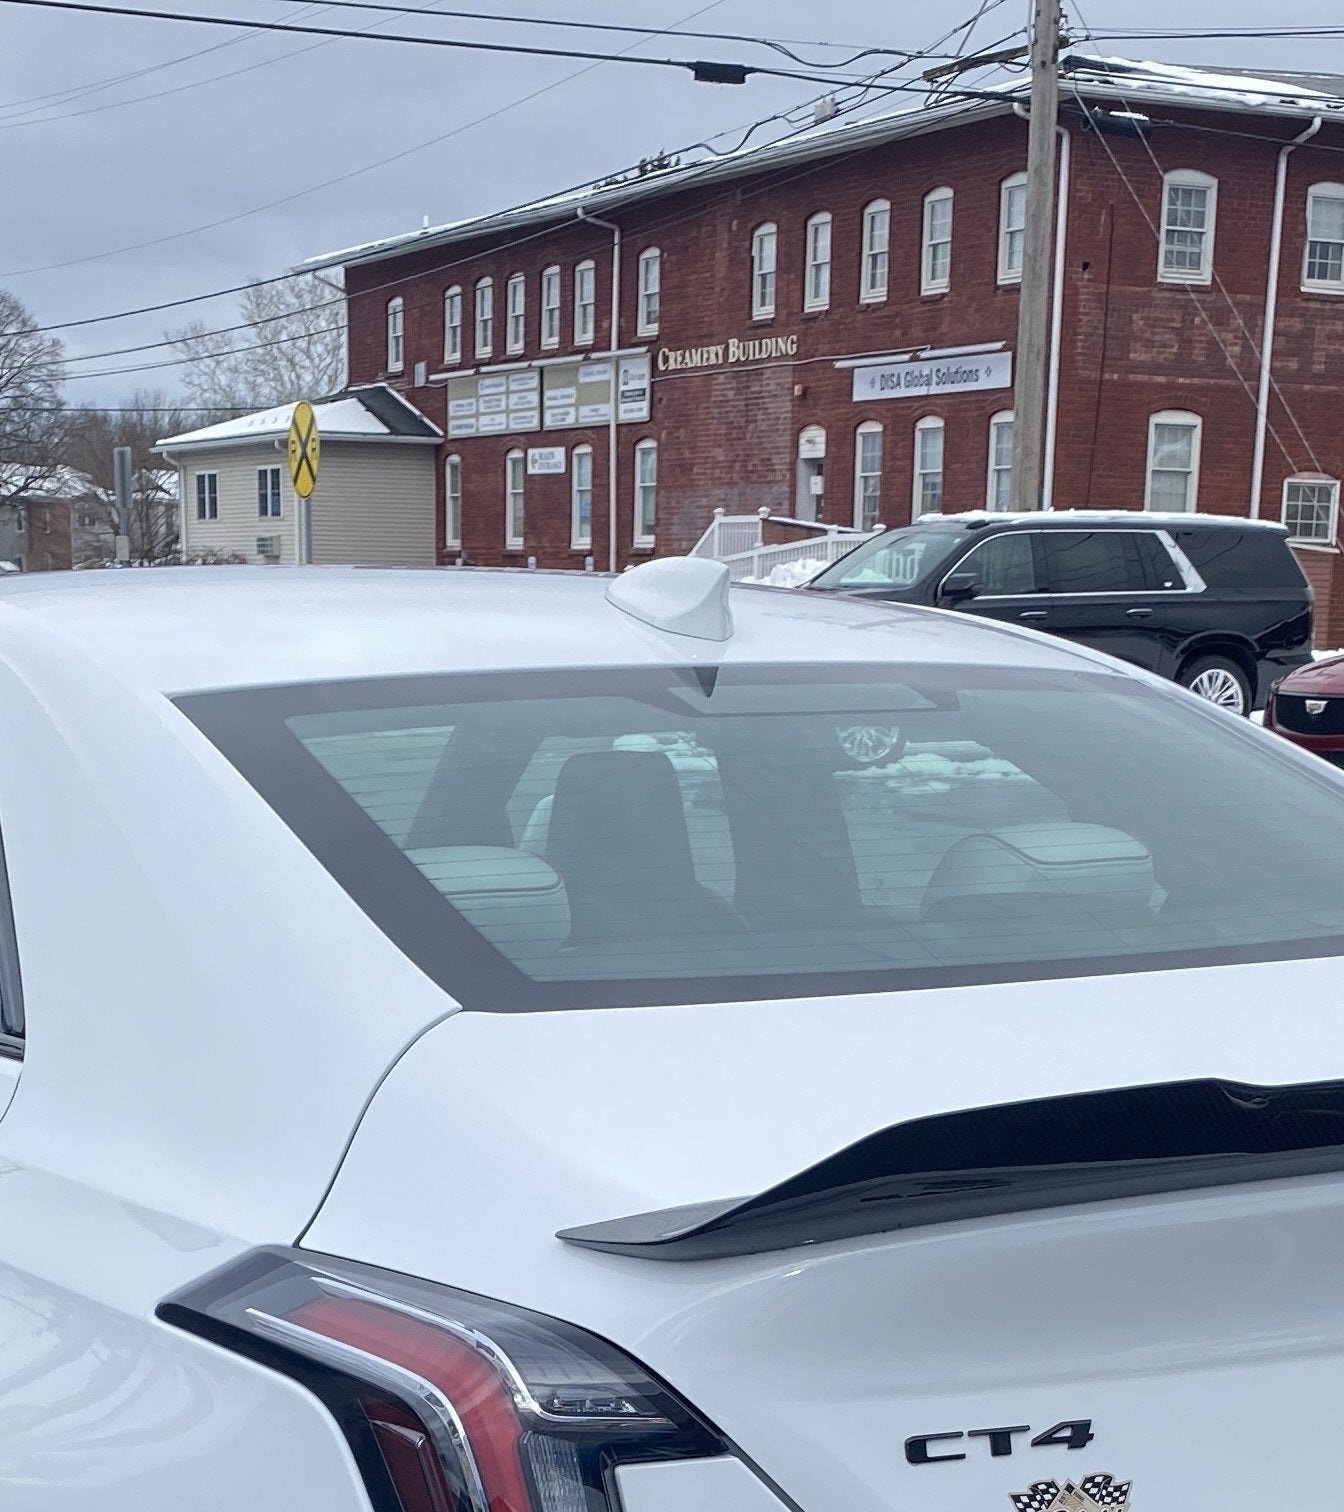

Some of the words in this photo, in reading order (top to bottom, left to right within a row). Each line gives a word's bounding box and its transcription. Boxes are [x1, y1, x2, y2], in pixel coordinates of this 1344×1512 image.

[657, 344, 726, 371] CREAMERY
[728, 334, 798, 363] BUILDING
[880, 372, 902, 391] DISA
[904, 367, 933, 388] Global
[935, 365, 980, 387] Solutions
[904, 1418, 1095, 1464] CT4
